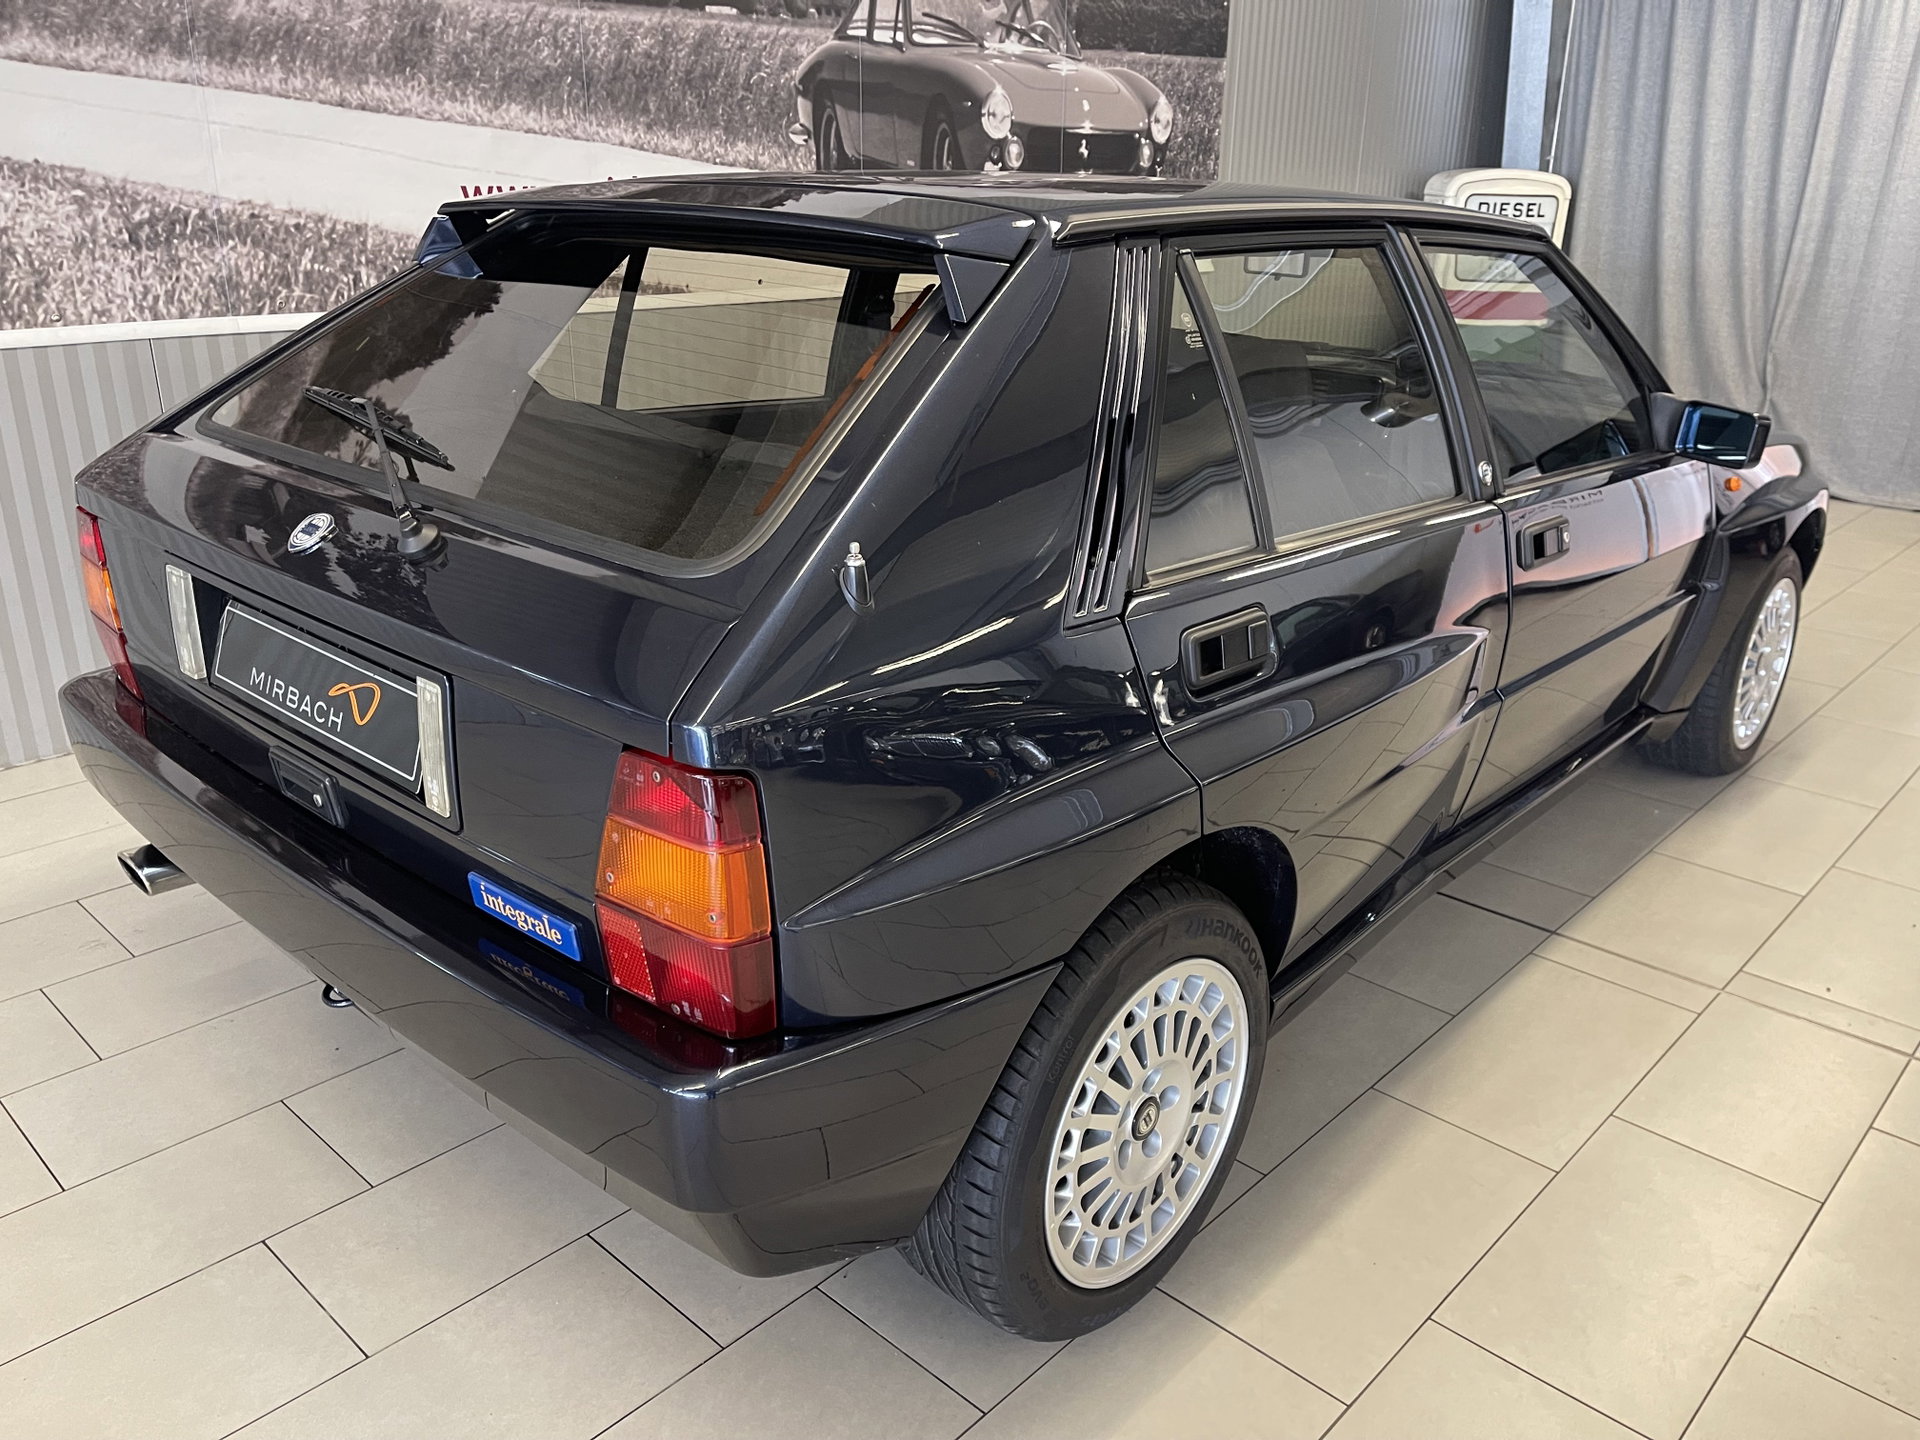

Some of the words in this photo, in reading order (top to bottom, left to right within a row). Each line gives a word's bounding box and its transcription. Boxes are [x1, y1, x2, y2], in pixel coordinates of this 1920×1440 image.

[1478, 202, 1545, 218] DIESEL
[249, 666, 344, 732] MIRBACH
[480, 881, 563, 945] integrale
[1200, 918, 1262, 979] Hankook
